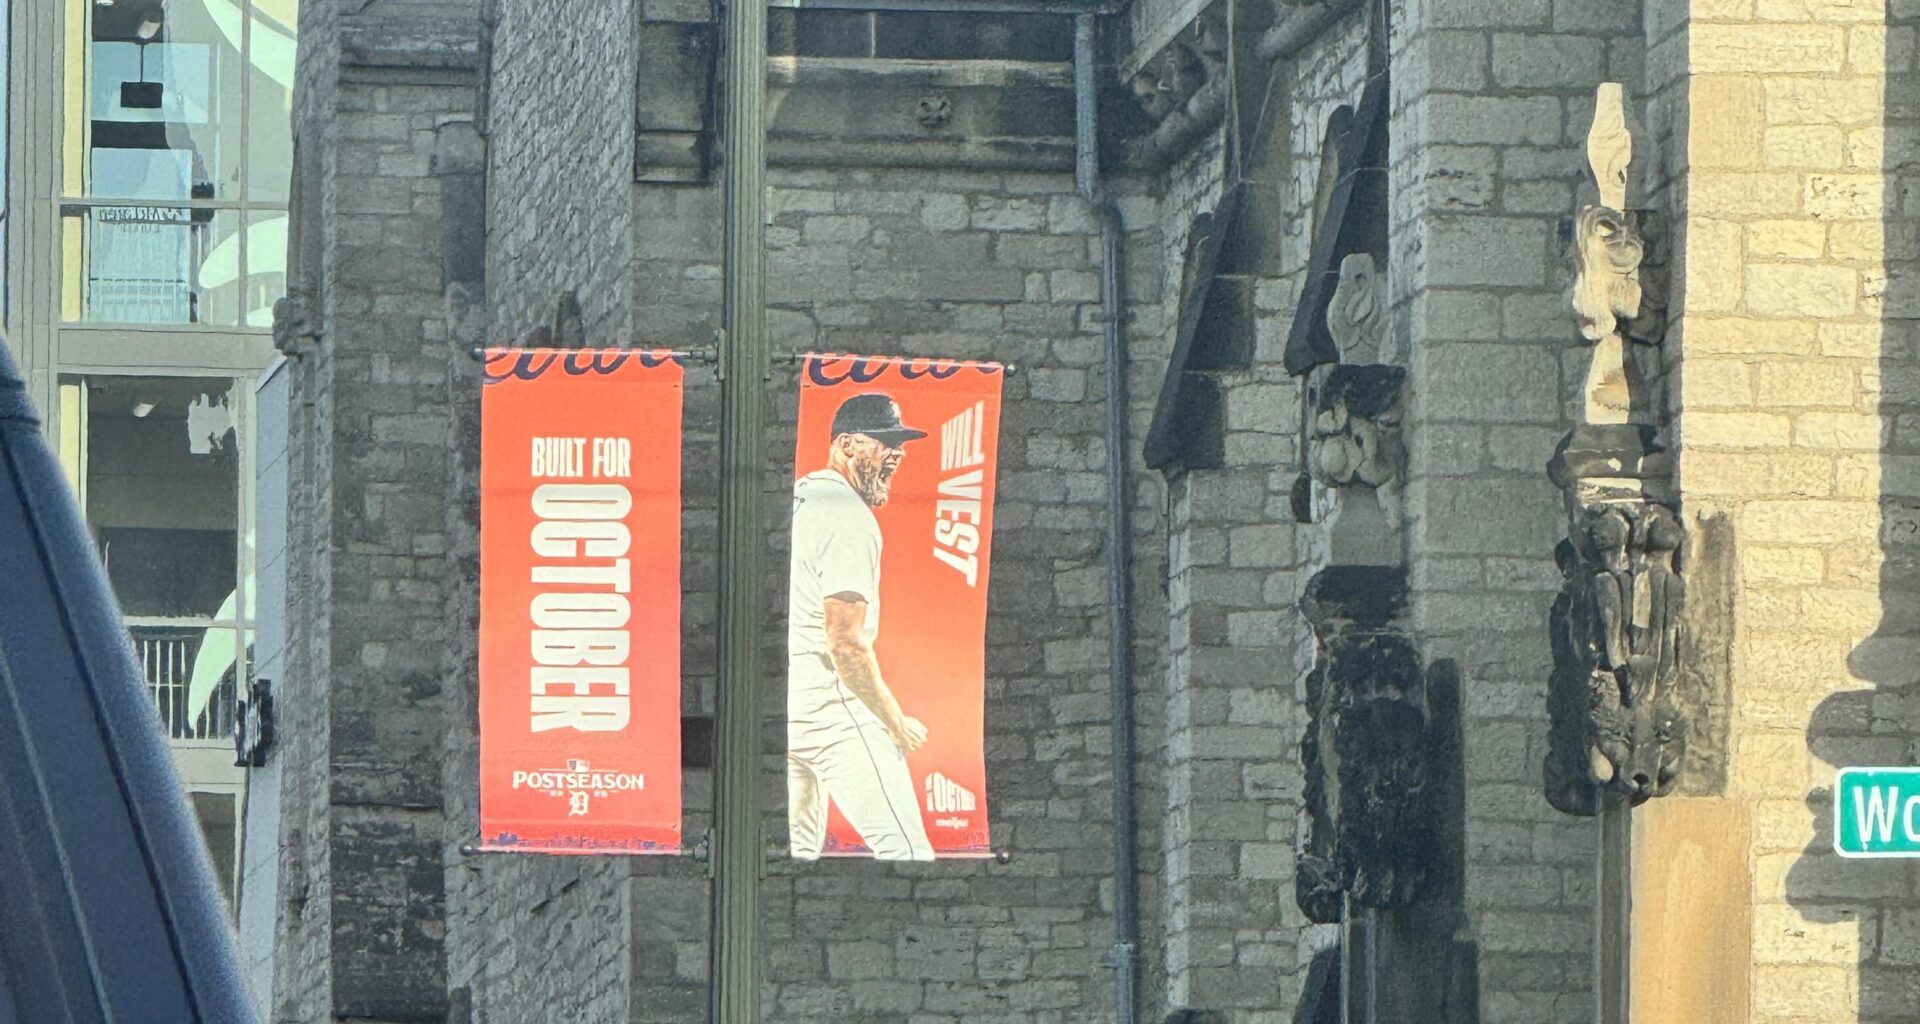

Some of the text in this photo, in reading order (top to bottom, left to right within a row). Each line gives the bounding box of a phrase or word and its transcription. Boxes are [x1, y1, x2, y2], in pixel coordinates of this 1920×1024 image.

[531, 437, 631, 477] BUILT FOR
[942, 400, 984, 470] WILL
[933, 470, 983, 587] VEST
[530, 484, 632, 732] OCTOBER
[512, 771, 644, 789] POSTSEASON
